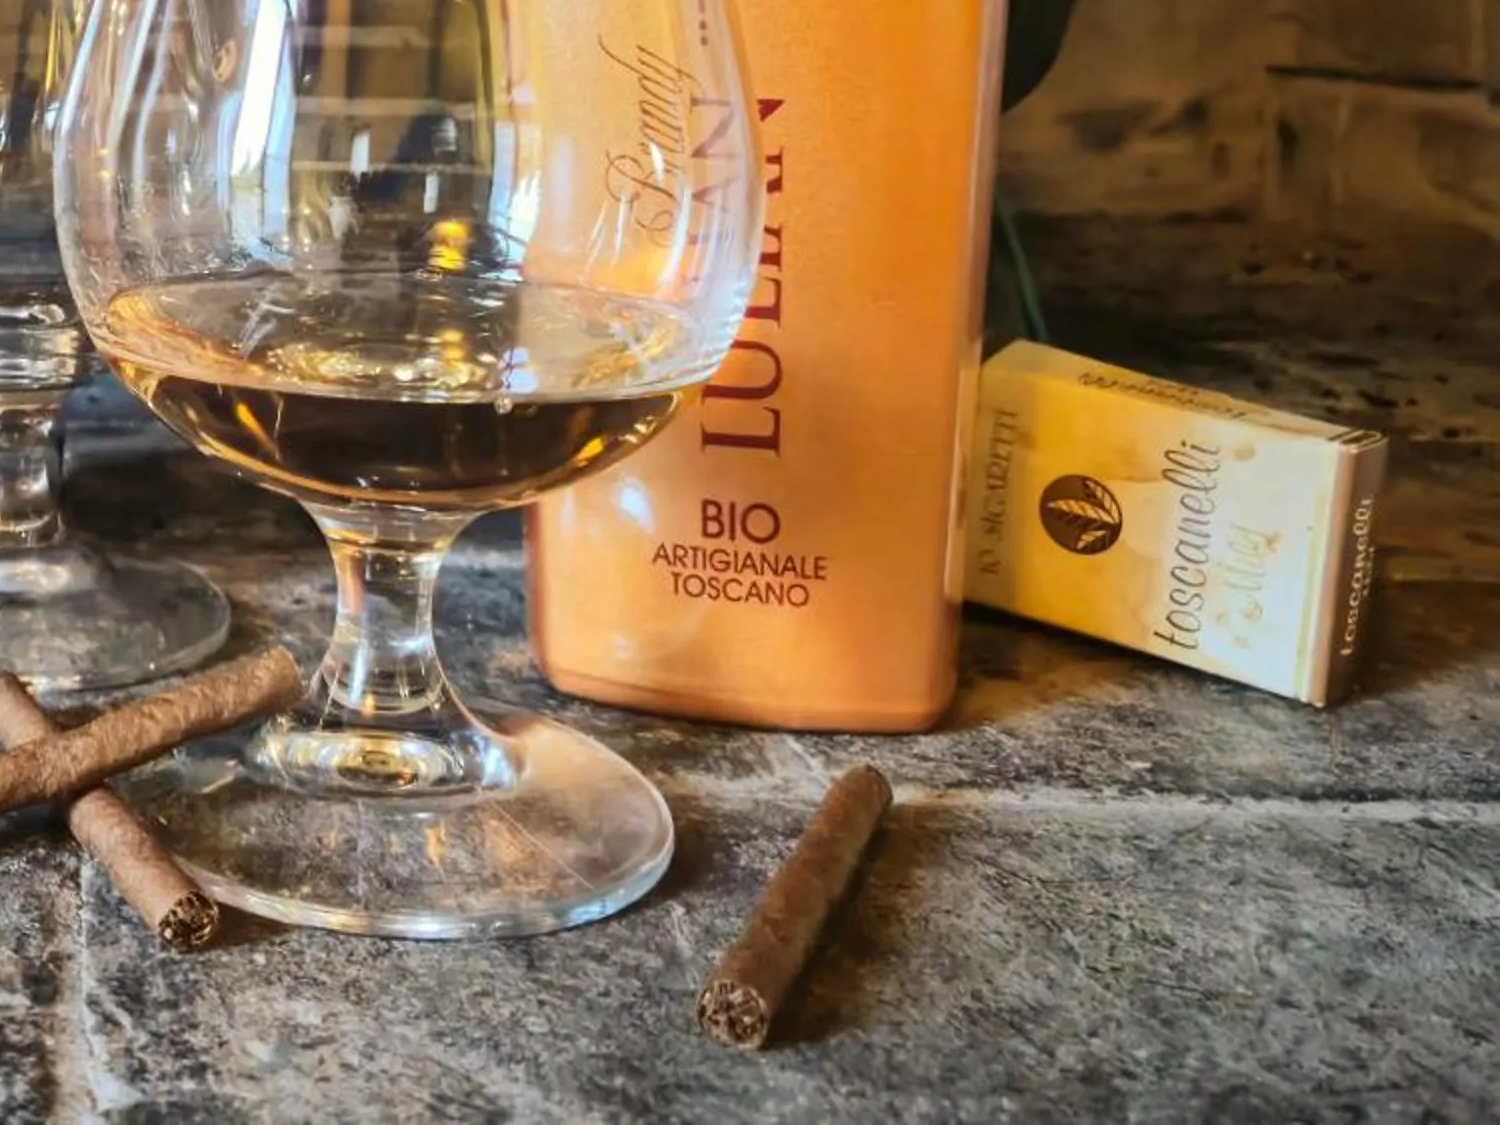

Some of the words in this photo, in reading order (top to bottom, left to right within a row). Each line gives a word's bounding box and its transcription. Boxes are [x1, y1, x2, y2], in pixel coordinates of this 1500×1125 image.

[700, 499, 782, 545] BIO
[652, 542, 828, 581] ARTIGIANALE
[1153, 439, 1222, 651] toscanelli
[670, 572, 811, 609] TOSCANO
